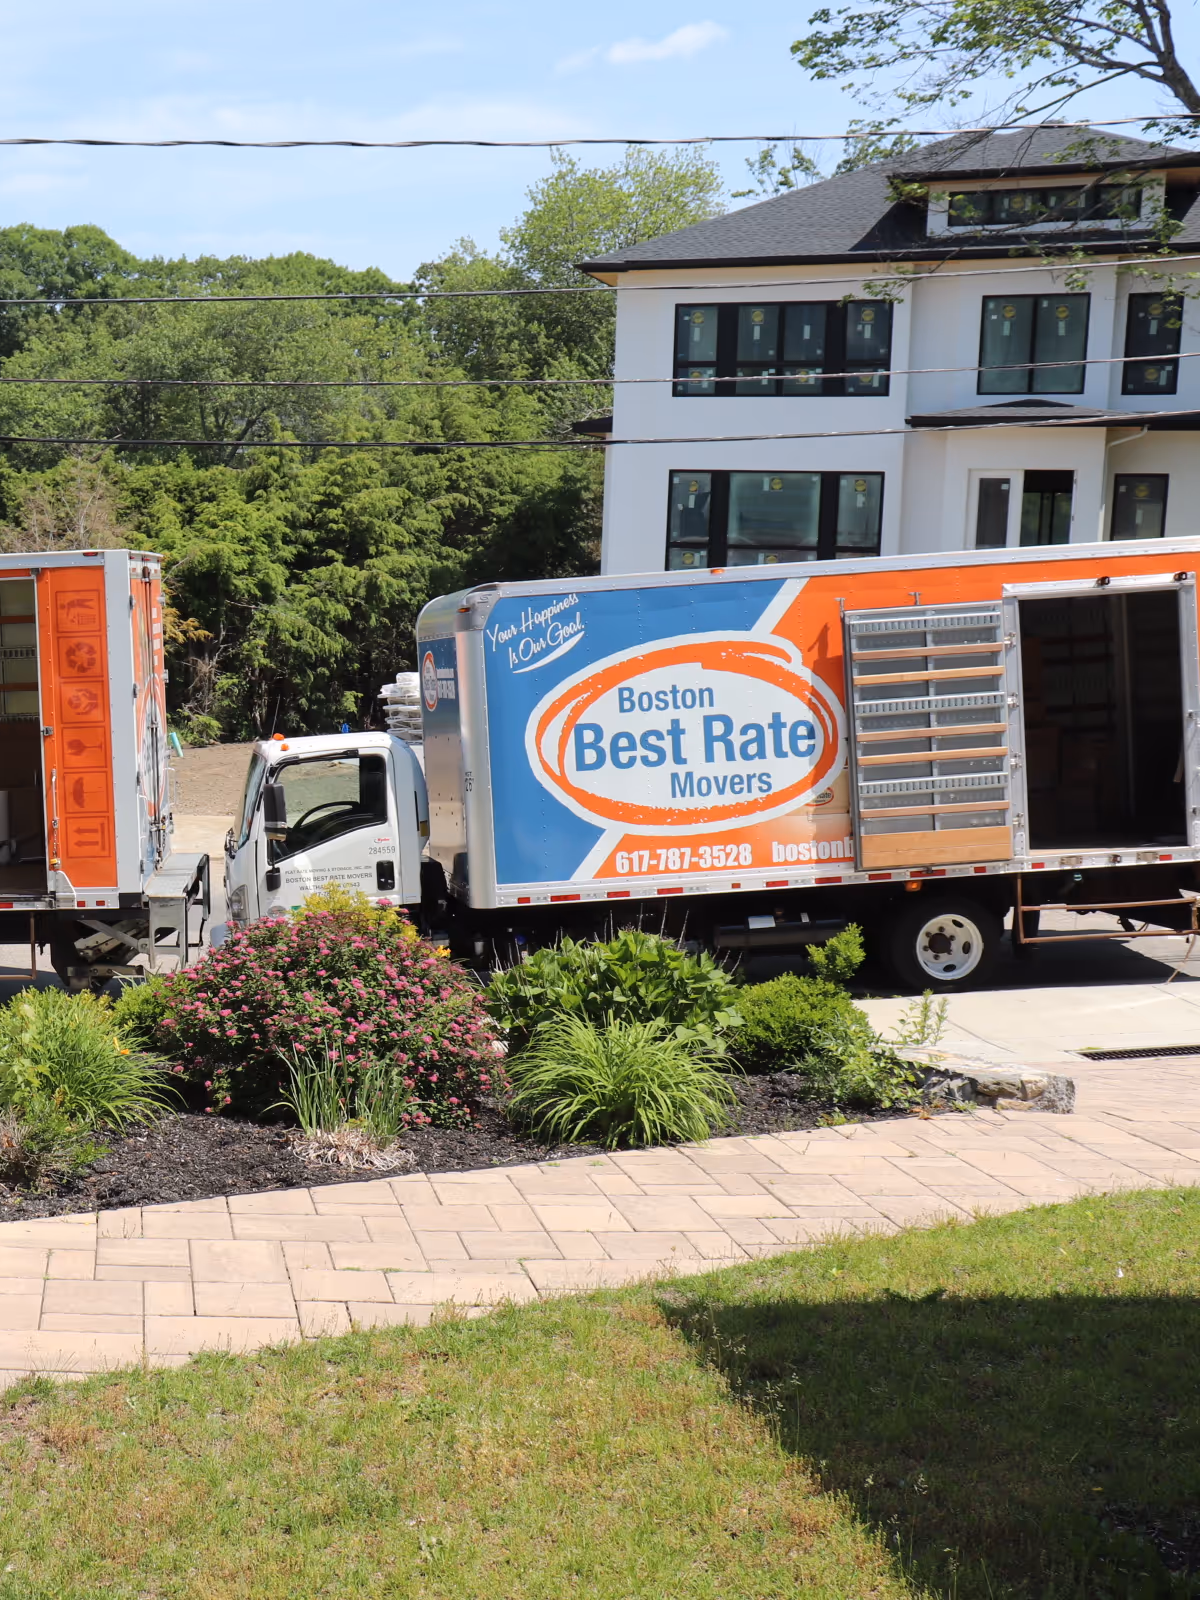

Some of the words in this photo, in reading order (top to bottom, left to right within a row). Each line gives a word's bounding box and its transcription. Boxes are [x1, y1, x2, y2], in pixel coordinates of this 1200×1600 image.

[486, 624, 518, 652] Your
[519, 593, 579, 633] Happiness
[508, 647, 518, 669] Is
[519, 637, 546, 661] Our
[547, 611, 585, 646] Goal.
[617, 684, 714, 713] Boston
[573, 718, 686, 772] Best
[703, 712, 816, 764] Rate
[670, 769, 772, 799] Movers
[368, 846, 396, 855] 284559
[615, 844, 753, 873] 617-787-3528
